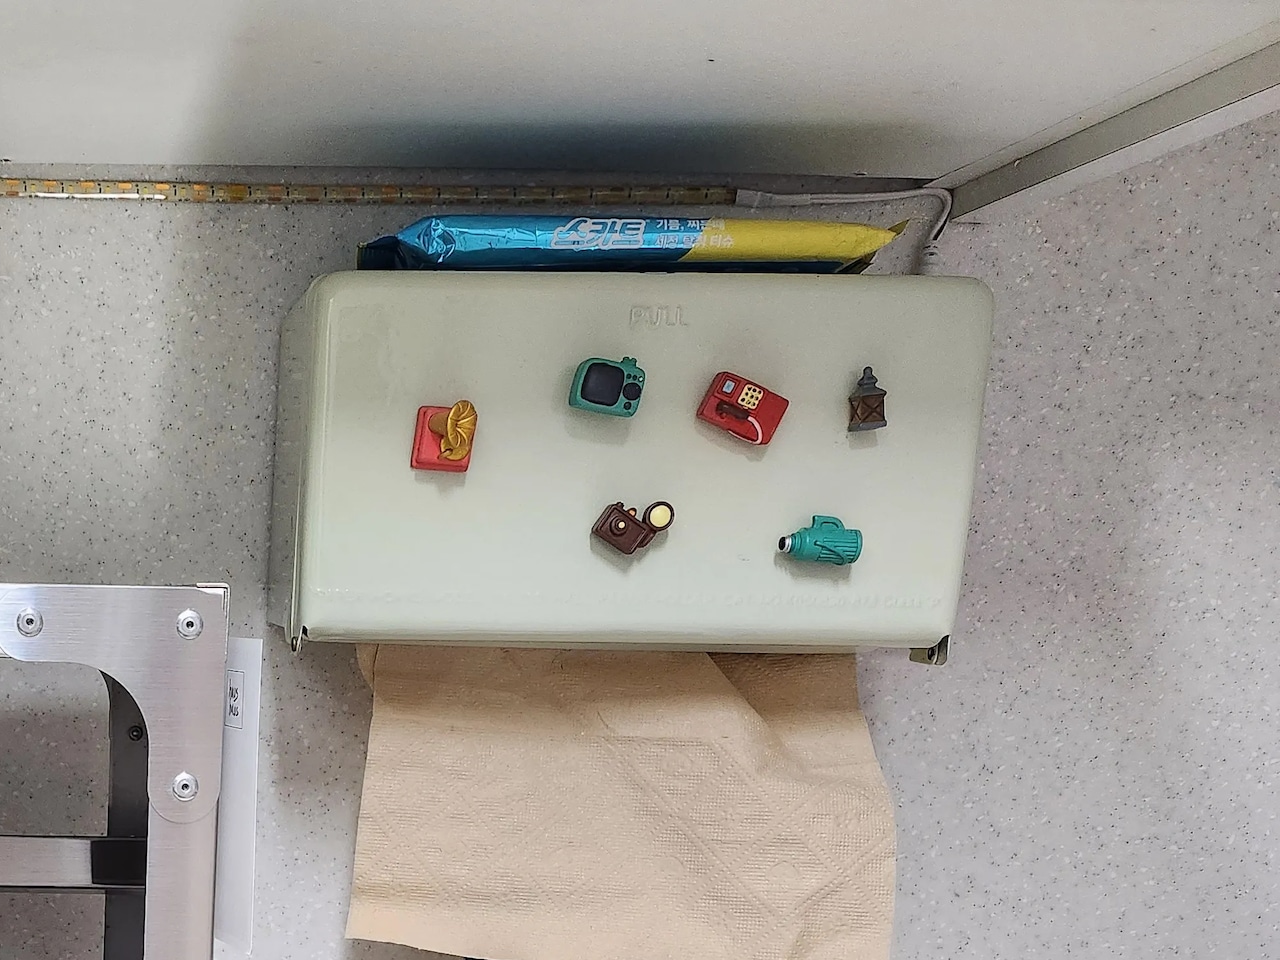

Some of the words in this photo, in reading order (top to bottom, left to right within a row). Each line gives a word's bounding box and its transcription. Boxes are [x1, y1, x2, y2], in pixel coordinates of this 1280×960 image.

[551, 217, 647, 250] 스카트
[656, 218, 685, 231] 기름,
[655, 233, 679, 249] 세정
[709, 234, 734, 248] 티슈
[629, 305, 688, 326] PULL
